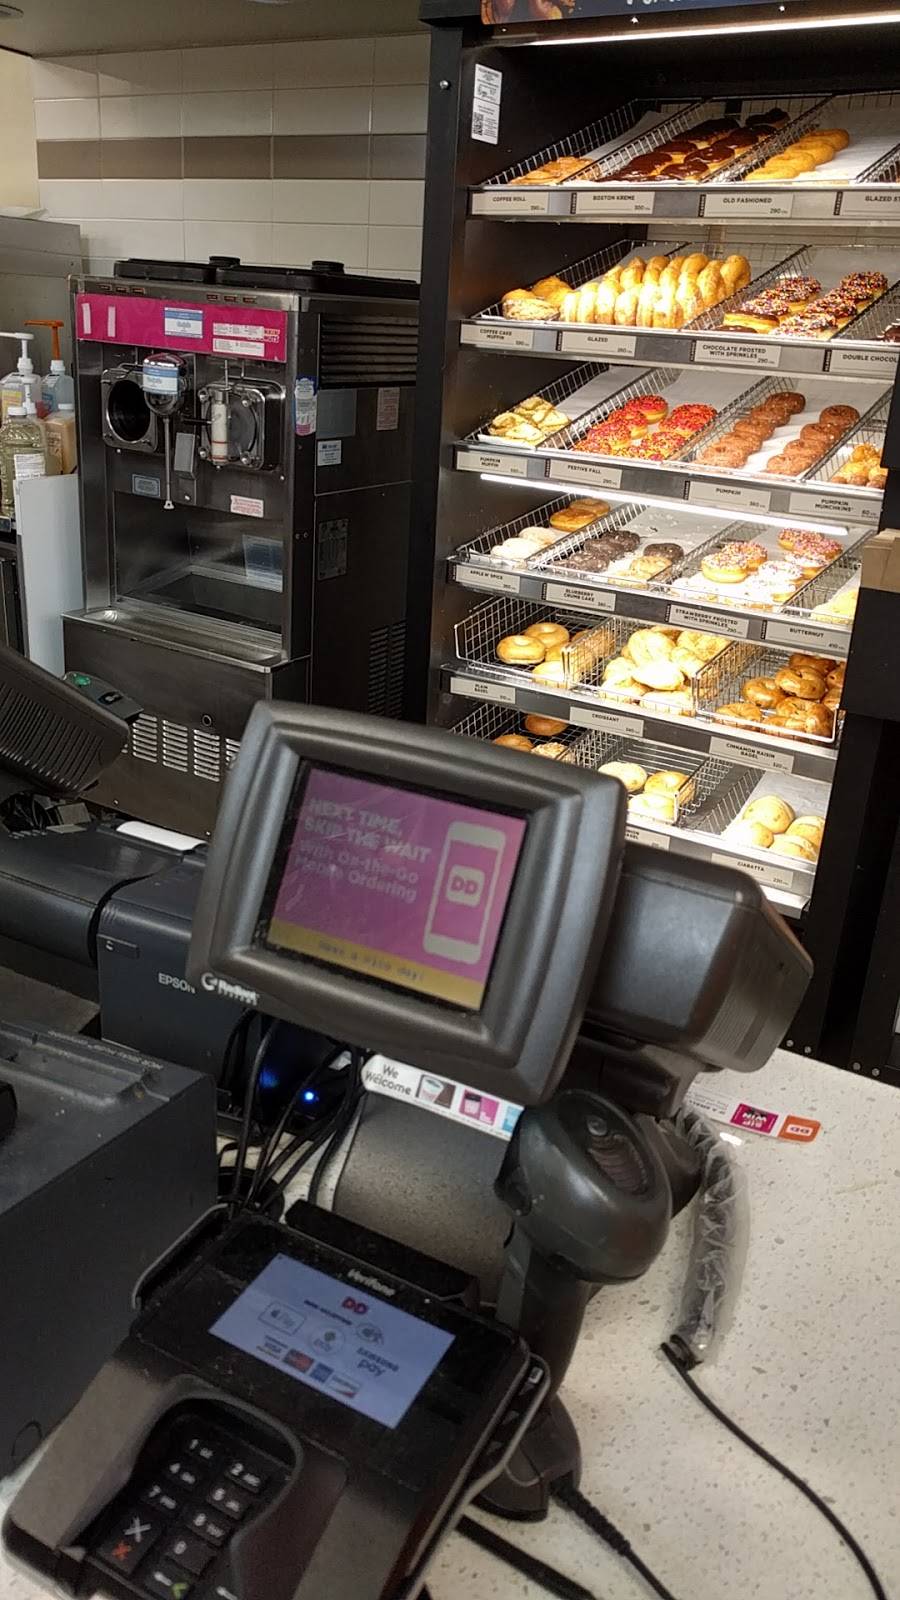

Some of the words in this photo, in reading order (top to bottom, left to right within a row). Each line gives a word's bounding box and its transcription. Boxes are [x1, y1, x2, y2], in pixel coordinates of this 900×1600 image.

[702, 344, 737, 352] CHOCOLATE
[568, 464, 587, 472] FESTIVE
[566, 588, 593, 596] BLUEBERRY
[675, 609, 712, 620] STRAWBERRY
[712, 615, 738, 625] FROSTED
[699, 617, 728, 628] SPRINKLES
[790, 627, 824, 638] BUTTERNUT
[591, 713, 619, 722] CROISSANT
[726, 743, 755, 754] CINNAMON
[308, 799, 354, 821] NEXT
[304, 818, 342, 837] SKIP
[347, 828, 380, 850] THE
[383, 838, 432, 863] WAIT
[737, 862, 764, 871] CIABATTA
[348, 871, 417, 904] Ordering
[451, 875, 479, 895] DD
[382, 1064, 399, 1079] We
[365, 1070, 411, 1096] Welcome
[742, 1112, 767, 1122] WIN
[342, 1296, 368, 1316] DD
[358, 1359, 384, 1377] pay
[231, 1463, 244, 1476] 2
